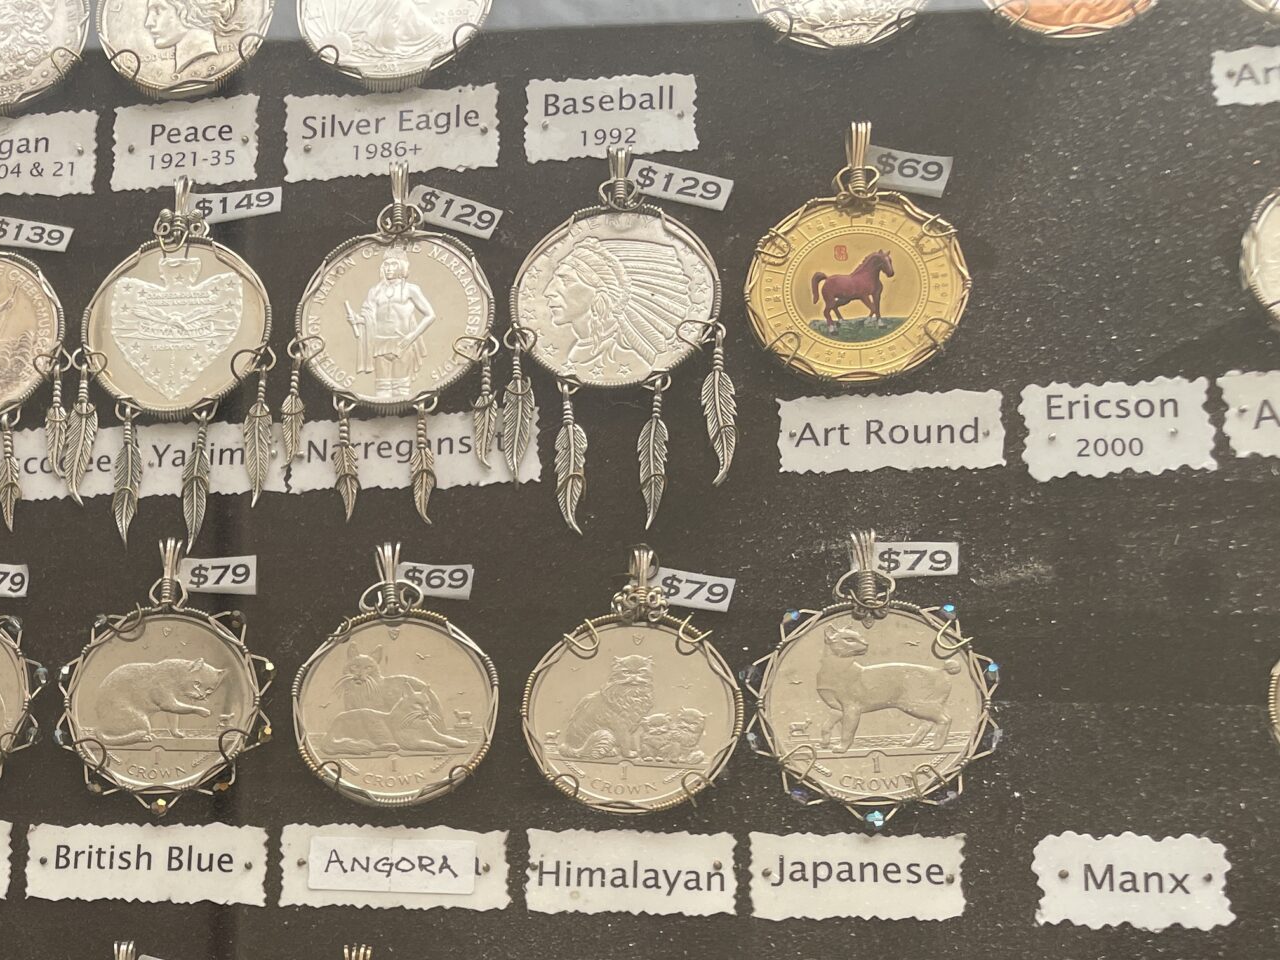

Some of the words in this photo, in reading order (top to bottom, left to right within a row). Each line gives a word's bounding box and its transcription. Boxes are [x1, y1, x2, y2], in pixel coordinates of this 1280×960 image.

[543, 85, 675, 117] Baseball
[149, 121, 233, 146] Peace
[301, 113, 386, 140] Silver
[398, 105, 481, 136] Eagle
[580, 127, 637, 146] 1992
[148, 149, 236, 171] 1921-35
[352, 142, 423, 161] 1986+
[30, 163, 44, 178] &
[51, 161, 76, 178] 21
[876, 152, 944, 182] $69
[635, 164, 721, 200] $129
[194, 191, 275, 218] $149
[418, 190, 496, 231] $129
[1045, 394, 1180, 420] Ericson
[793, 422, 850, 448] Art
[865, 419, 980, 445] Round
[1077, 437, 1144, 458] 2000
[876, 547, 953, 573] $79
[189, 563, 251, 588] $79
[404, 567, 470, 591] $69
[661, 573, 729, 604] $79
[54, 844, 153, 872] British
[167, 846, 235, 874] Blue
[324, 850, 459, 879] ANGORA
[770, 855, 945, 889] Japanese
[537, 860, 726, 896] Himalayan
[1083, 863, 1191, 895] Manx
